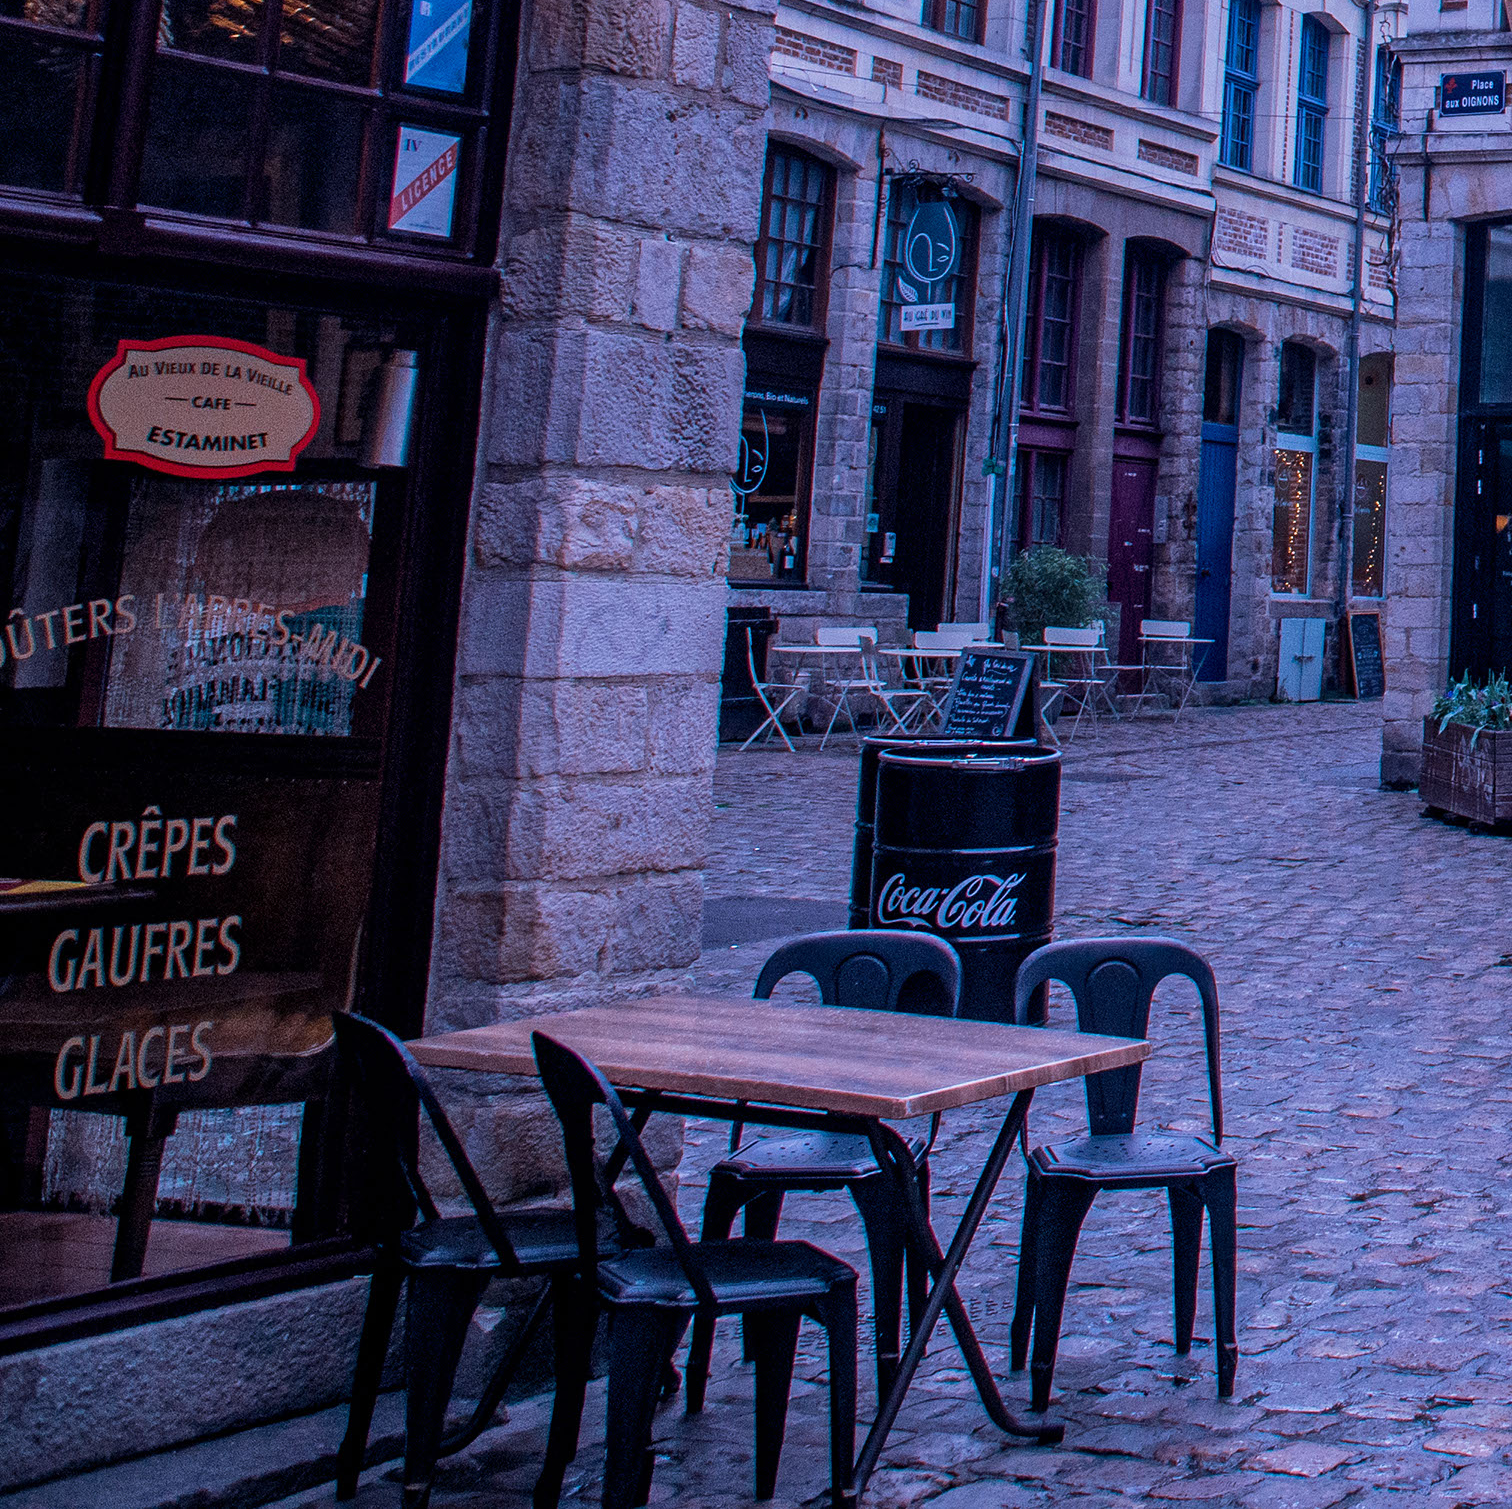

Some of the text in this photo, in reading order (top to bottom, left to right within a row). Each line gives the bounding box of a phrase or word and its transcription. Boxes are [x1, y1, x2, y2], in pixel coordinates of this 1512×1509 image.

[1445, 94, 1500, 108] aux OIGNONS
[1471, 79, 1494, 90] Place
[404, 138, 422, 151] IV
[401, 150, 453, 211] LICENCE
[154, 361, 195, 375] VIEUX
[200, 362, 221, 375] DE
[225, 364, 242, 379] LA
[247, 368, 294, 396] VIEILLE
[191, 396, 232, 410] CAFE
[146, 426, 268, 451] ESTAMINET
[77, 805, 238, 886] CRÊPES
[878, 872, 1028, 928] Coca-Cola
[48, 915, 243, 993] GAUFRES
[54, 1021, 215, 1101] GLACES
